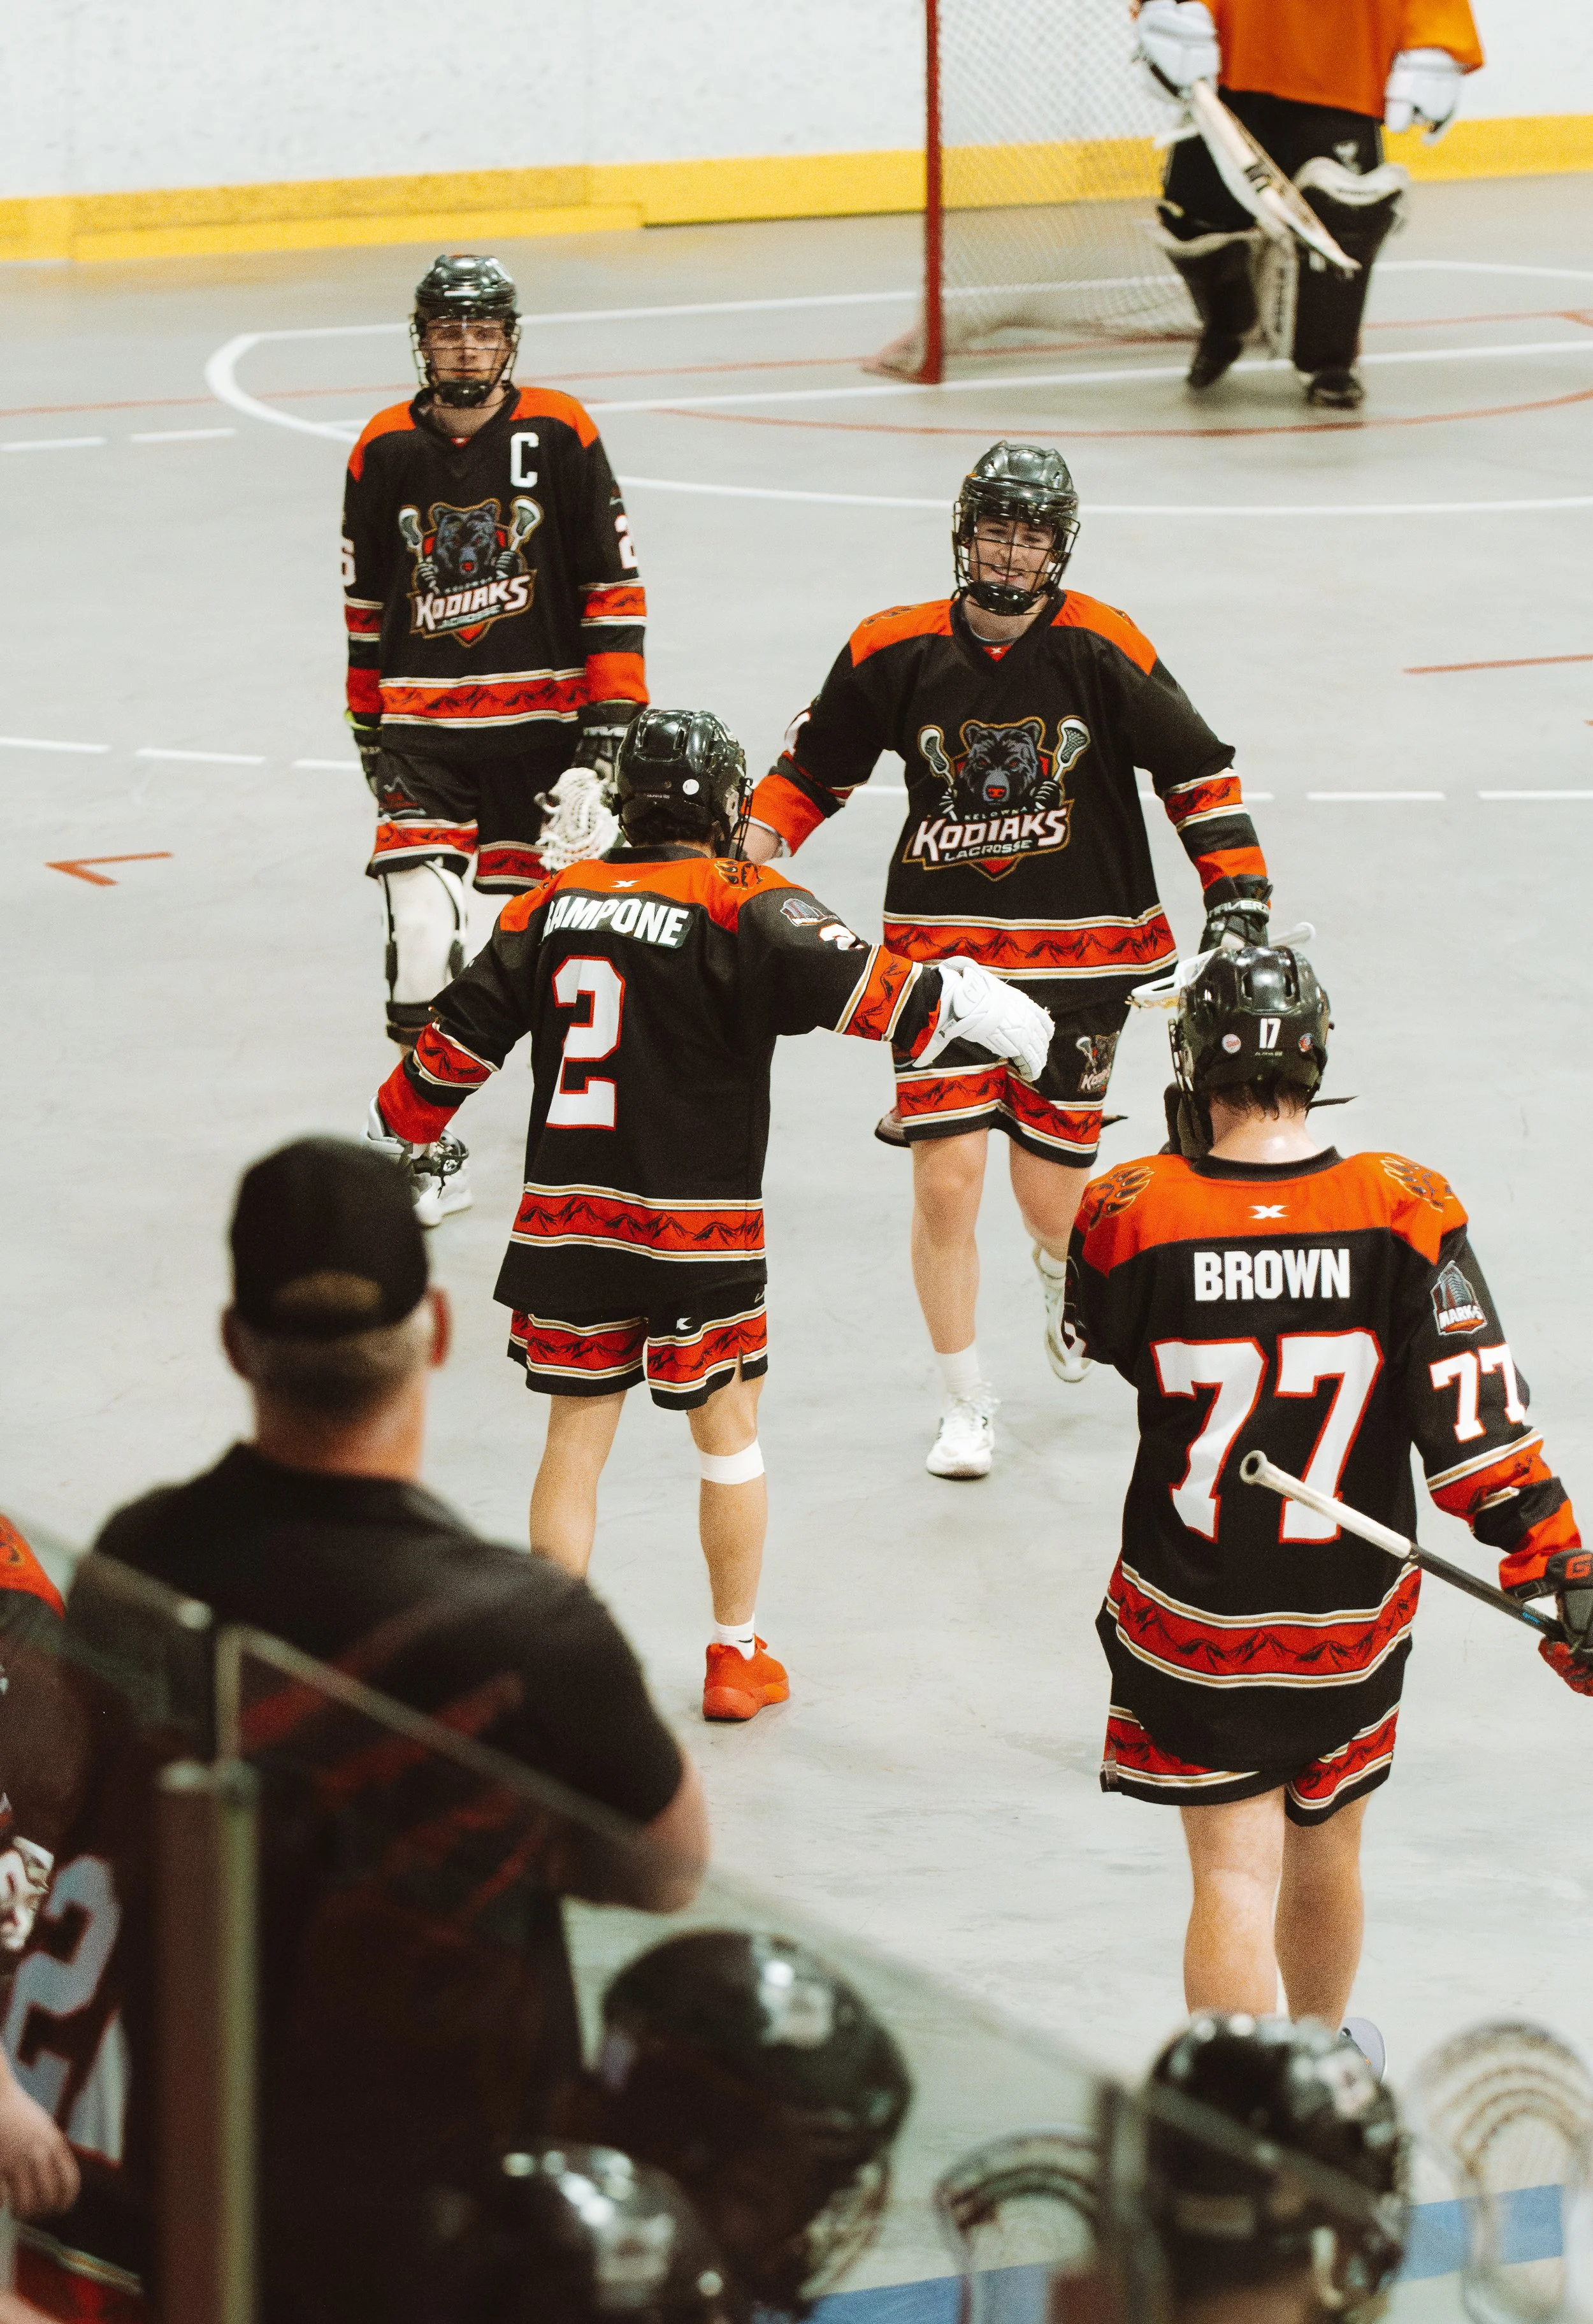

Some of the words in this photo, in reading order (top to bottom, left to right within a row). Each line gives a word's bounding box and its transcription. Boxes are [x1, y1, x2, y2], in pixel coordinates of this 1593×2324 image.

[510, 431, 539, 488] C
[415, 574, 531, 631] KODIAKS
[912, 807, 1068, 862] KODIAKS
[944, 839, 1034, 862] LACROSSE
[545, 955, 626, 1130] 2
[1259, 1018, 1281, 1049] 17
[1193, 1248, 1350, 1301] BROWN
[1429, 1342, 1527, 1443] 77
[1151, 1327, 1385, 1545] 77
